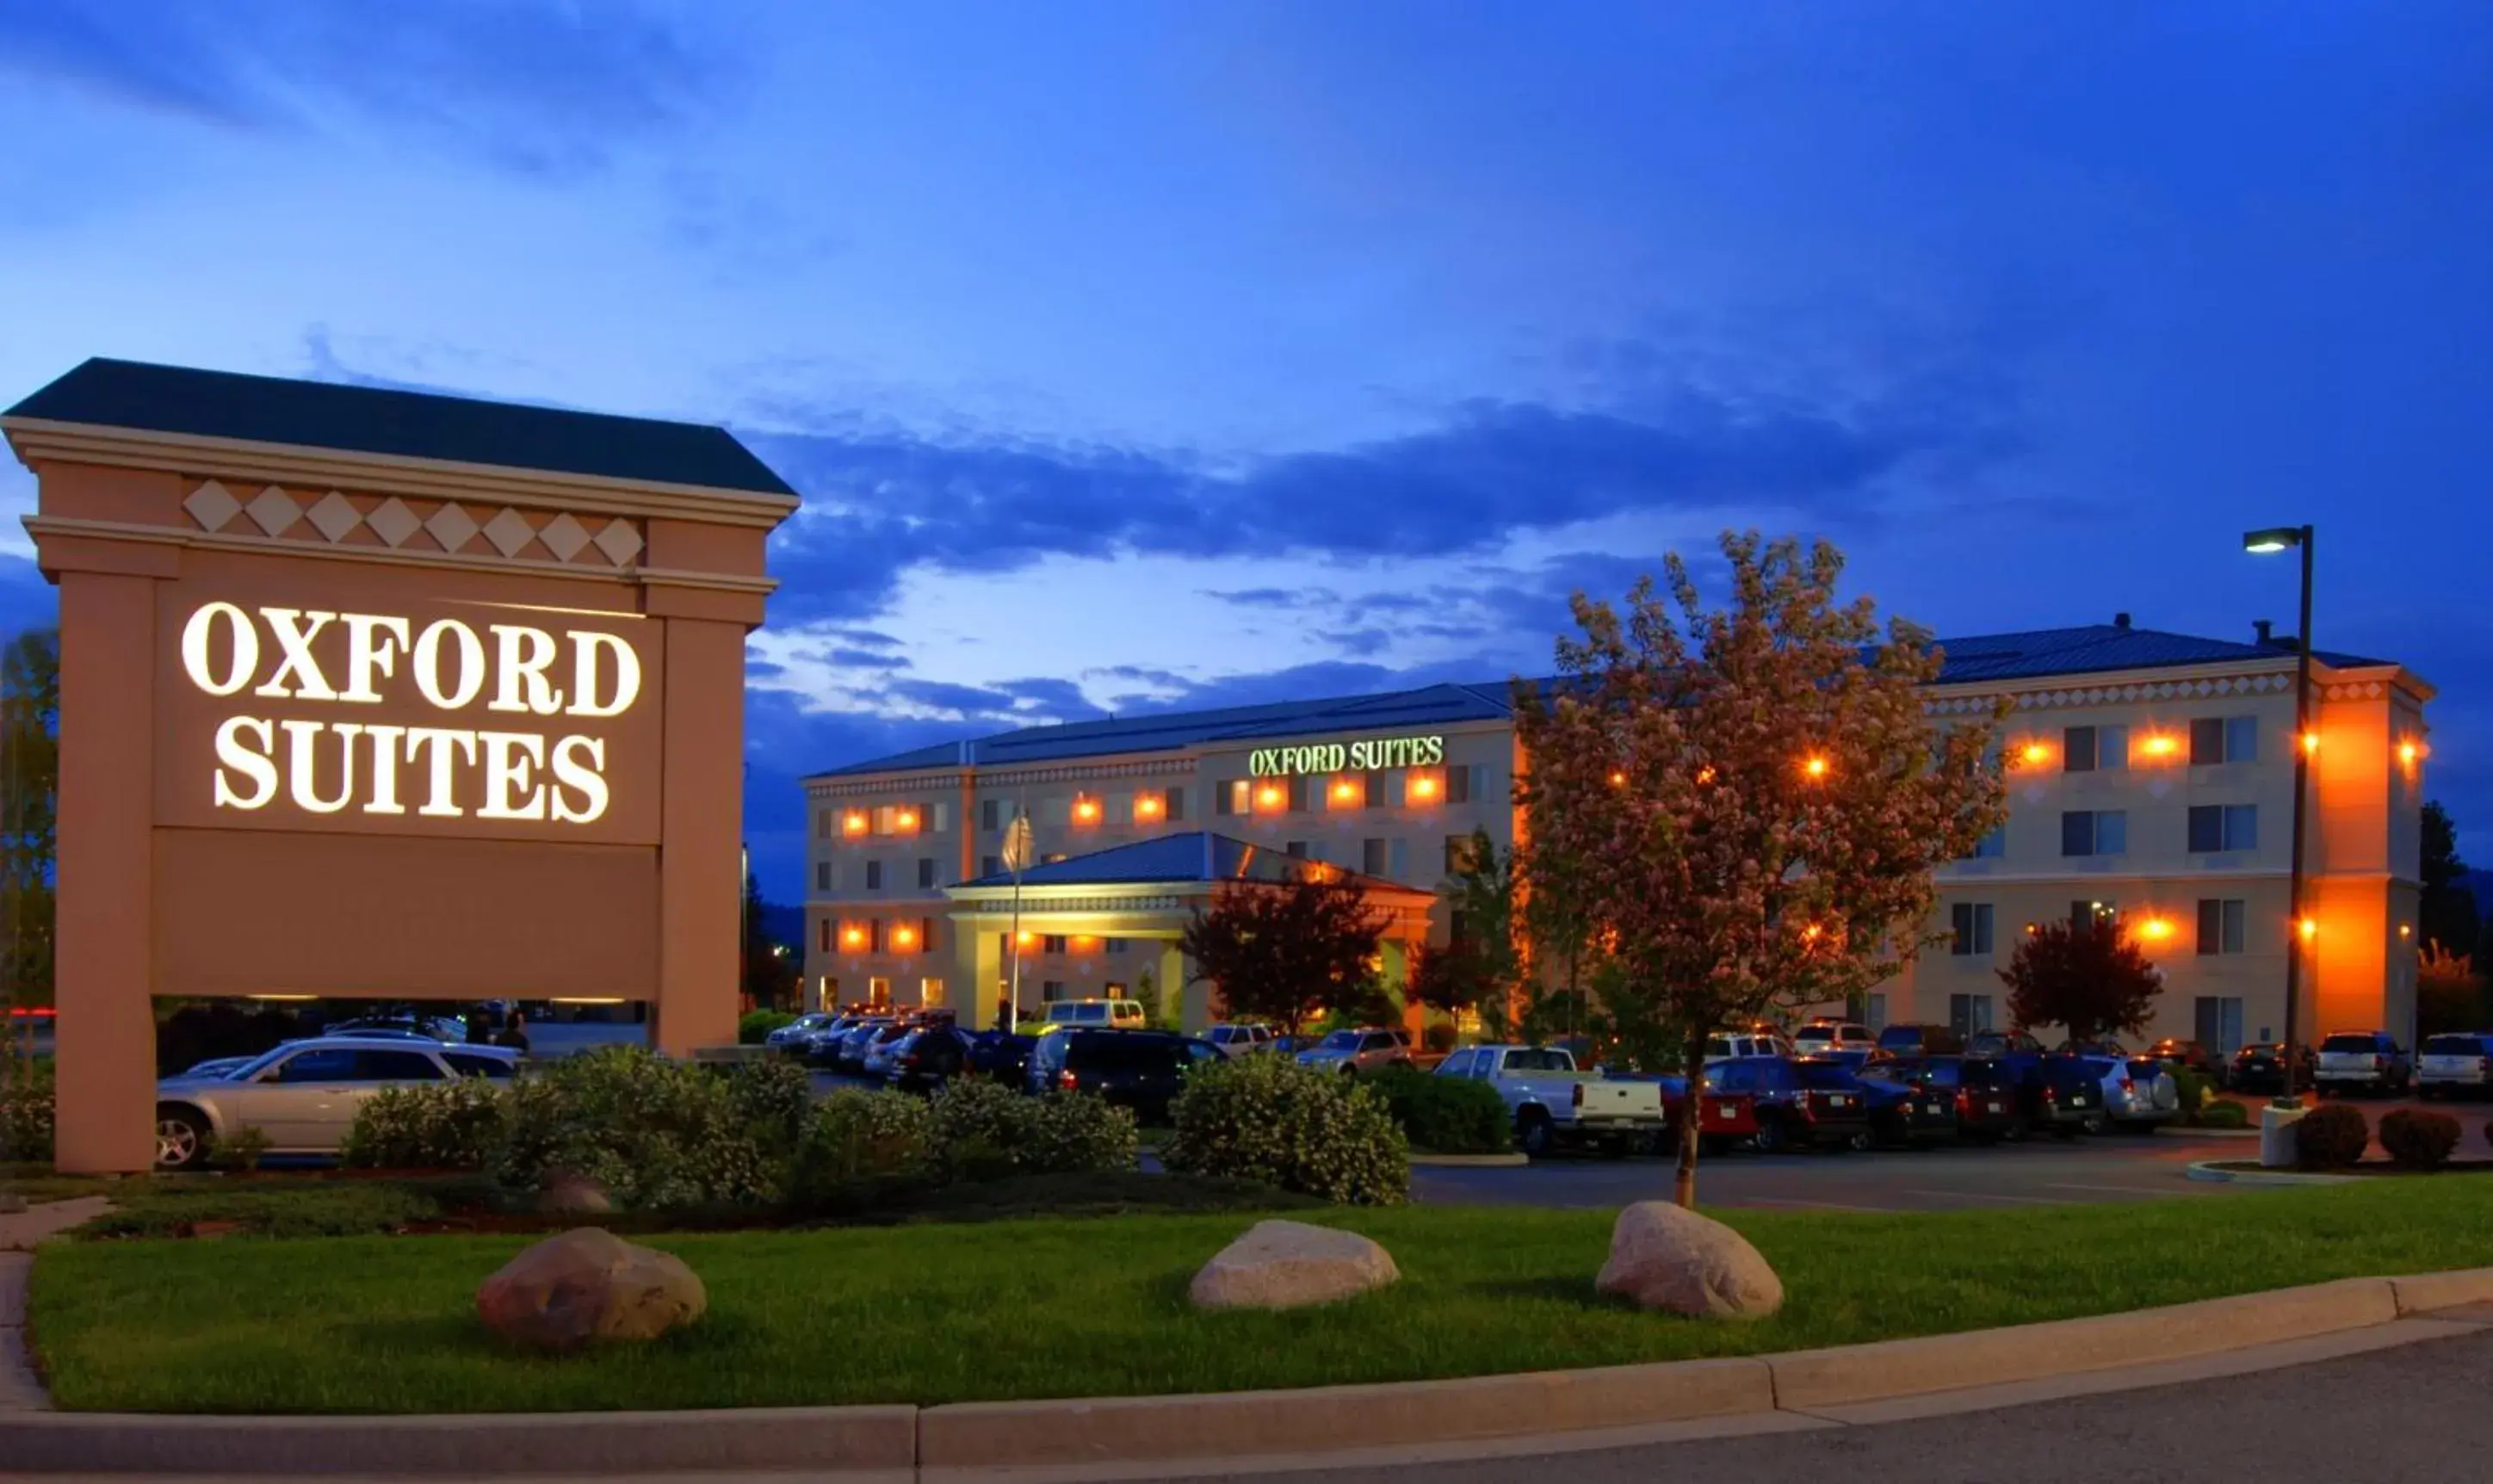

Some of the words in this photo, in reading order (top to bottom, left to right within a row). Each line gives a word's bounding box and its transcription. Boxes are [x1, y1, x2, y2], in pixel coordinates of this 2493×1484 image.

[182, 602, 641, 716] OXFORD
[214, 716, 609, 823] SUITES
[1250, 744, 1345, 776] OXFORD
[1351, 736, 1444, 770] SUITES
